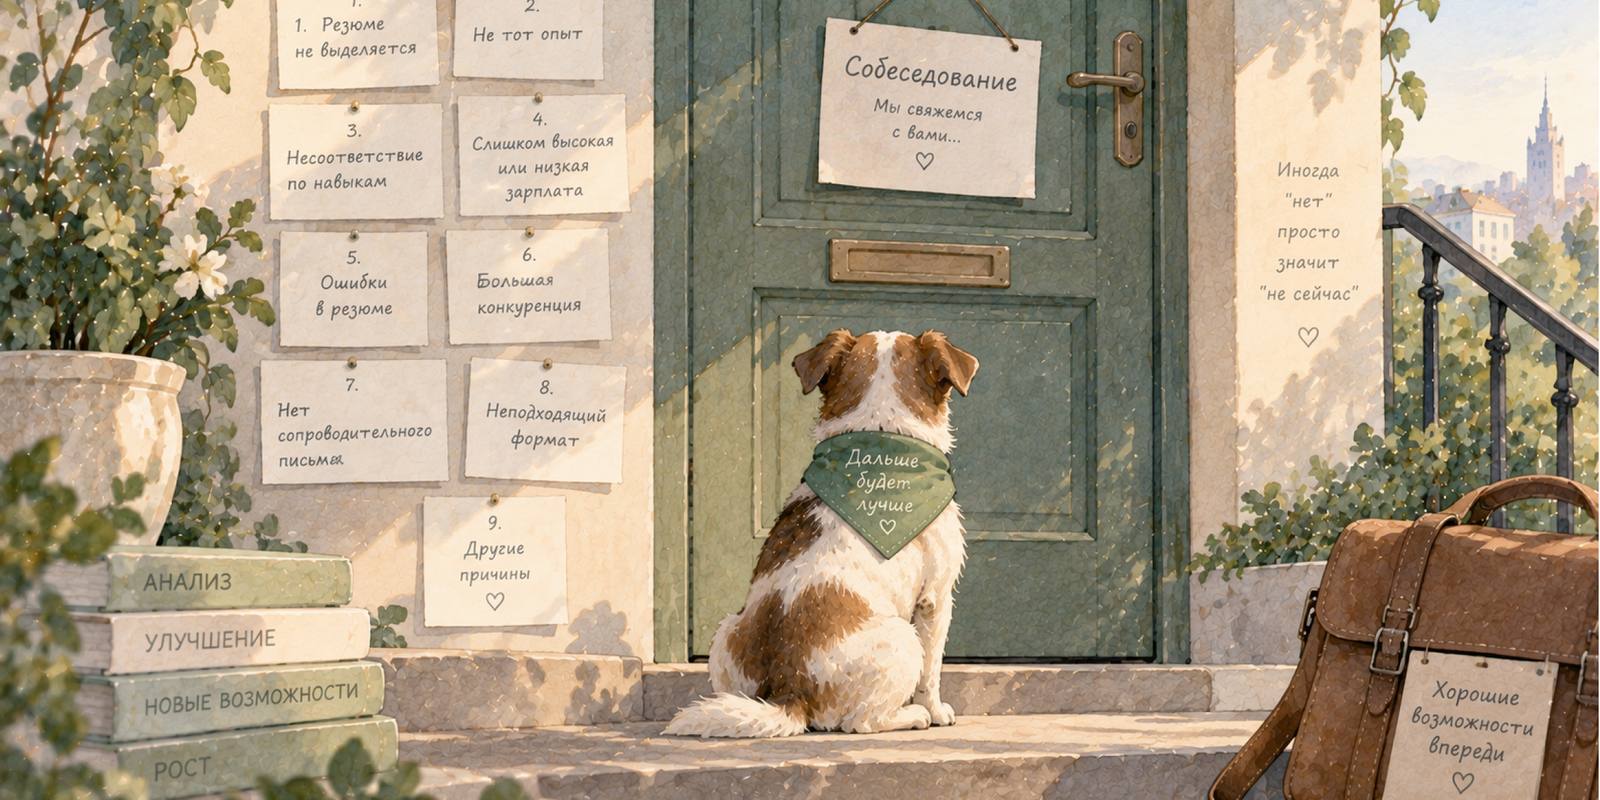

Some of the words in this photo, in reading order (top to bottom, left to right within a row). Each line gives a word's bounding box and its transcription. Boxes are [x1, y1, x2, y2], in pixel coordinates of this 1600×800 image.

[525, 0, 539, 12] 2.
[296, 18, 306, 32] 1.
[323, 17, 384, 35] Резюме
[474, 27, 494, 41] Не
[502, 31, 533, 41] тот
[541, 30, 583, 40] опыт
[296, 48, 313, 58] не
[321, 42, 416, 59] выделяется
[845, 55, 1017, 91] Собеседование
[874, 98, 900, 113] Мы
[907, 107, 982, 122] свяжемся
[533, 112, 546, 126] 4.
[347, 124, 361, 137] 3.
[893, 129, 900, 137] с
[908, 125, 961, 143] вами...
[473, 136, 545, 151] Слишком
[552, 133, 613, 148] высокая
[288, 150, 423, 164] Несоответствие
[499, 165, 526, 174] или
[535, 162, 588, 176] низкая
[1278, 162, 1339, 180] Иногда
[288, 180, 306, 190] по
[314, 173, 386, 189] навыкам
[505, 187, 583, 203] зарплата
[1286, 193, 1332, 208] "нет"
[1278, 227, 1340, 243] просто
[347, 251, 360, 264] 5.
[523, 247, 536, 261] 6.
[1276, 258, 1339, 273] значит
[321, 273, 386, 289] Ошибки
[477, 273, 553, 288] Большая
[1260, 285, 1285, 300] "не
[1294, 285, 1358, 300] сейчас"
[316, 300, 324, 315] в
[331, 305, 392, 320] резюме
[478, 301, 581, 318] конкуренция
[346, 378, 358, 391] 7.
[540, 380, 553, 394] 8.
[278, 403, 310, 417] Нет
[487, 403, 605, 424] Неподходящий
[278, 425, 432, 446] сопроводительного
[511, 429, 579, 450] формат
[845, 449, 919, 468] Дальше
[856, 500, 913, 516] лучше
[489, 516, 501, 530] 9.
[464, 541, 524, 560] Другие
[143, 573, 231, 591] АНАЛИЗ
[460, 568, 530, 587] причины
[145, 629, 276, 652] УЛУЧШЕНИЕ
[145, 694, 211, 715] НОВЫЕ
[220, 684, 358, 709] ВОЗМОЖНОСТИ
[1432, 680, 1519, 706] Хорошие
[1411, 706, 1533, 736] возможности
[1429, 736, 1504, 763] впереди
[155, 756, 211, 782] РОСТ
